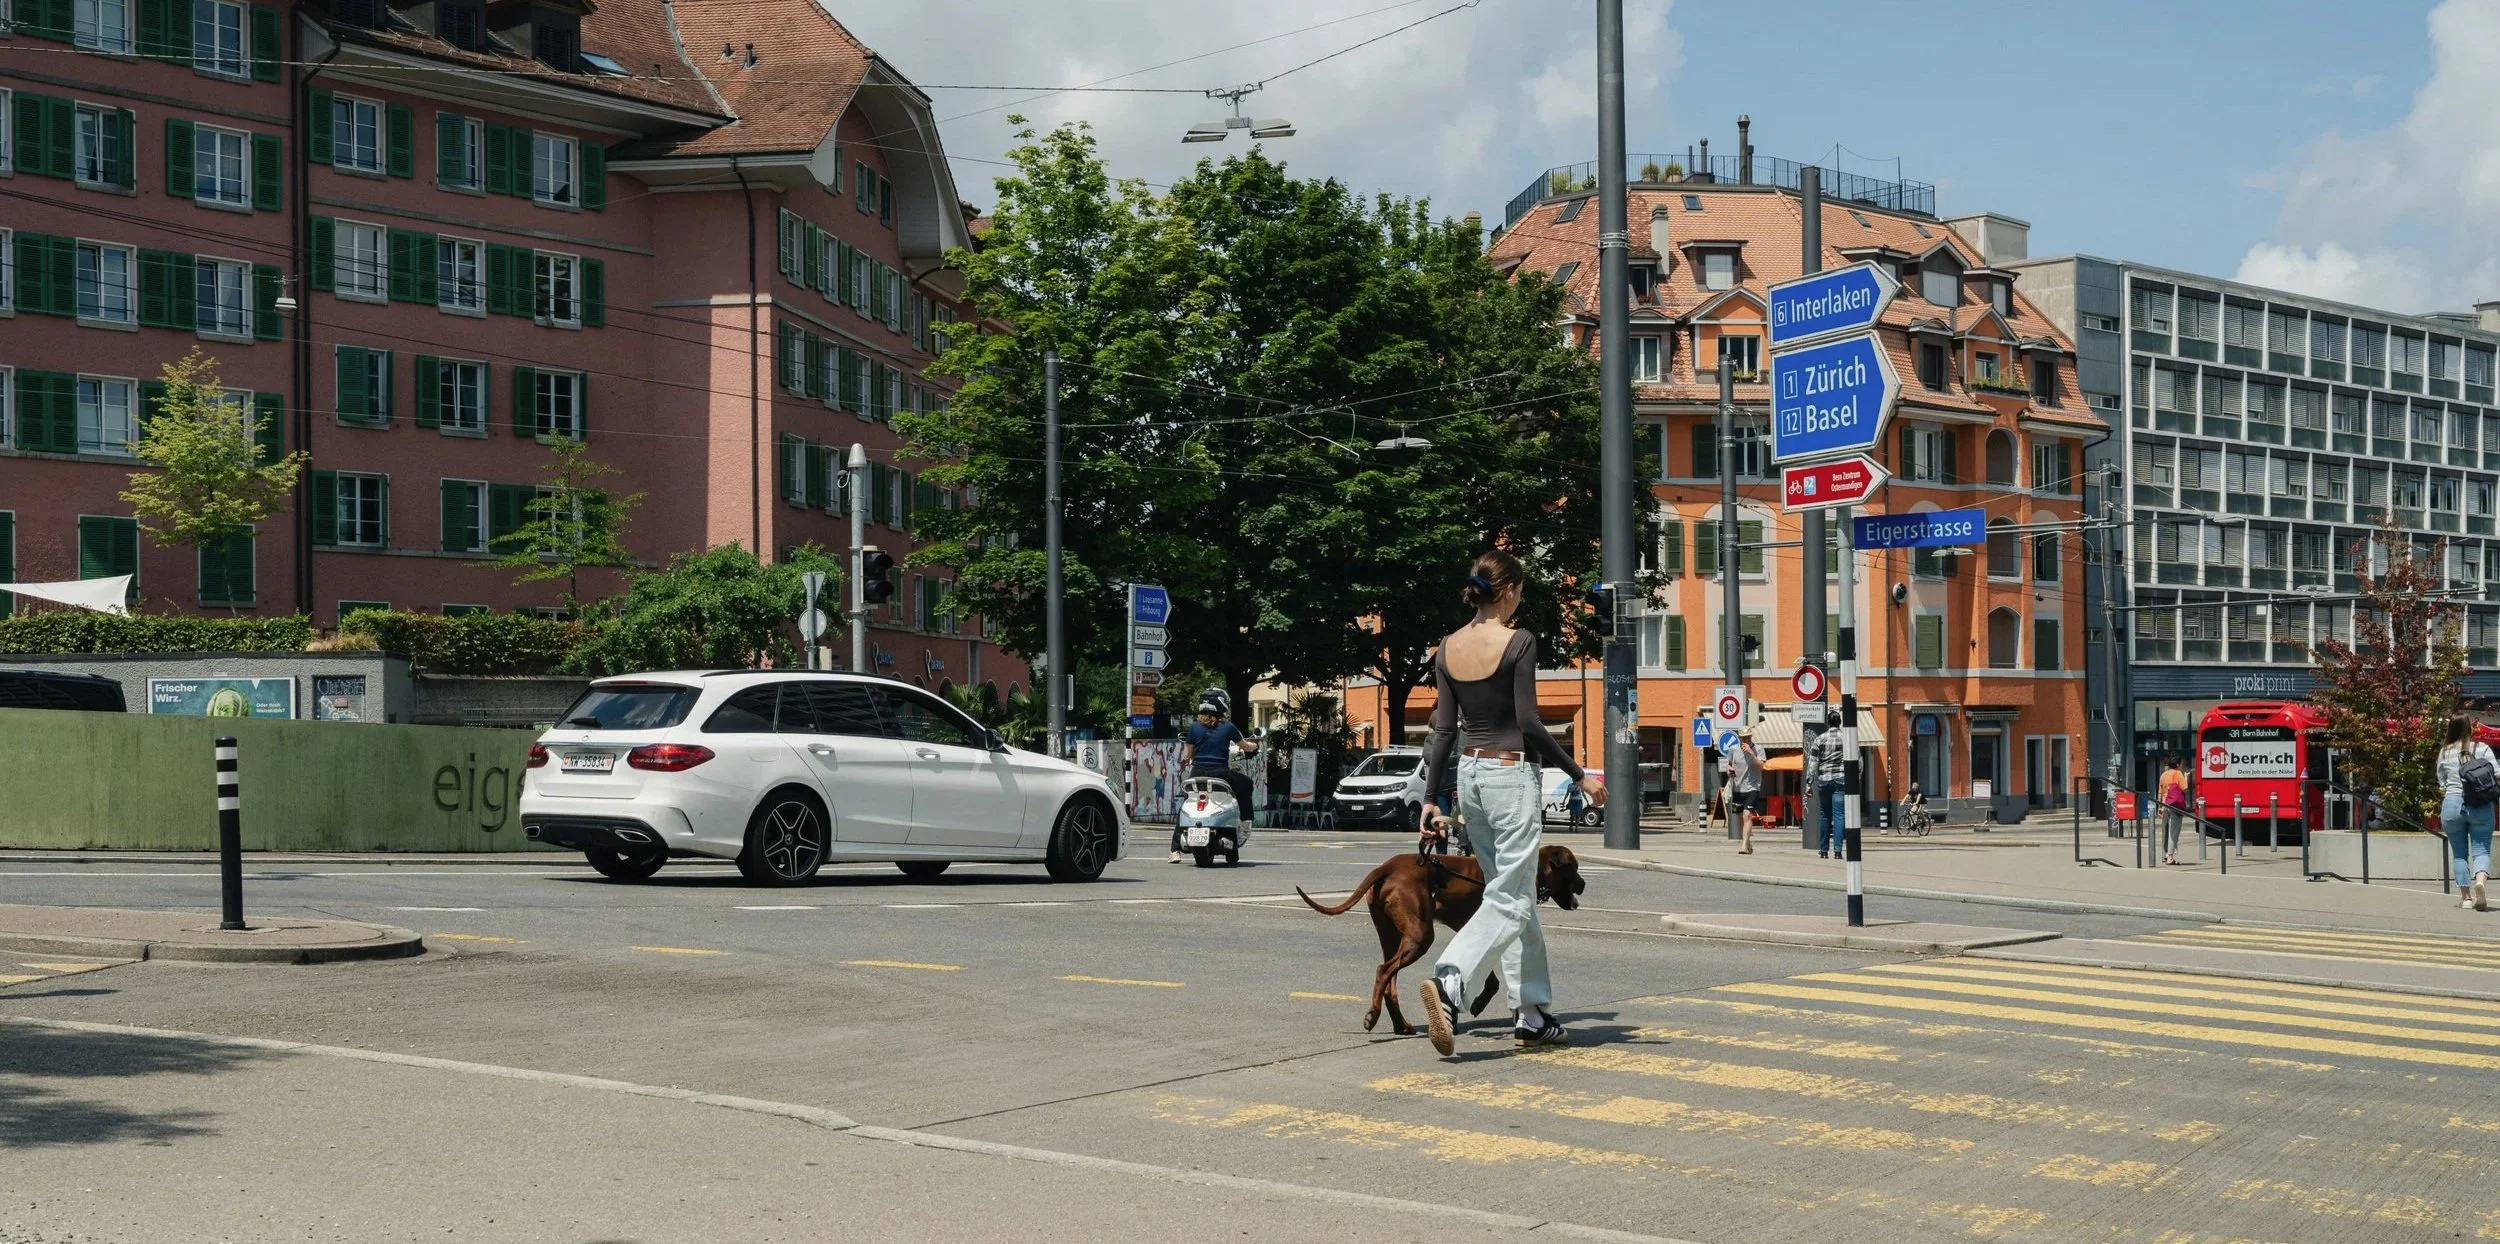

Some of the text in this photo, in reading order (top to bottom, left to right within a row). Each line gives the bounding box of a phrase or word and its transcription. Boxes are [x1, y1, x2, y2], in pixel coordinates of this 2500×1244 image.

[1777, 285, 1871, 323] 6 Interlaken
[1787, 355, 1866, 395] 1 Zürich
[1785, 394, 1857, 433] 12 Basel
[1832, 471, 1861, 482] Bern Zentrum
[1831, 480, 1863, 492] Ostermundigen
[1866, 521, 1972, 545] Eigerstrasse
[1136, 629, 1163, 641] Bahnhof
[155, 684, 198, 693] Frischer
[2234, 673, 2295, 696] proki print
[155, 694, 182, 703] Wirz.
[1725, 703, 1734, 713] 30
[2256, 728, 2279, 737] Bahnhof
